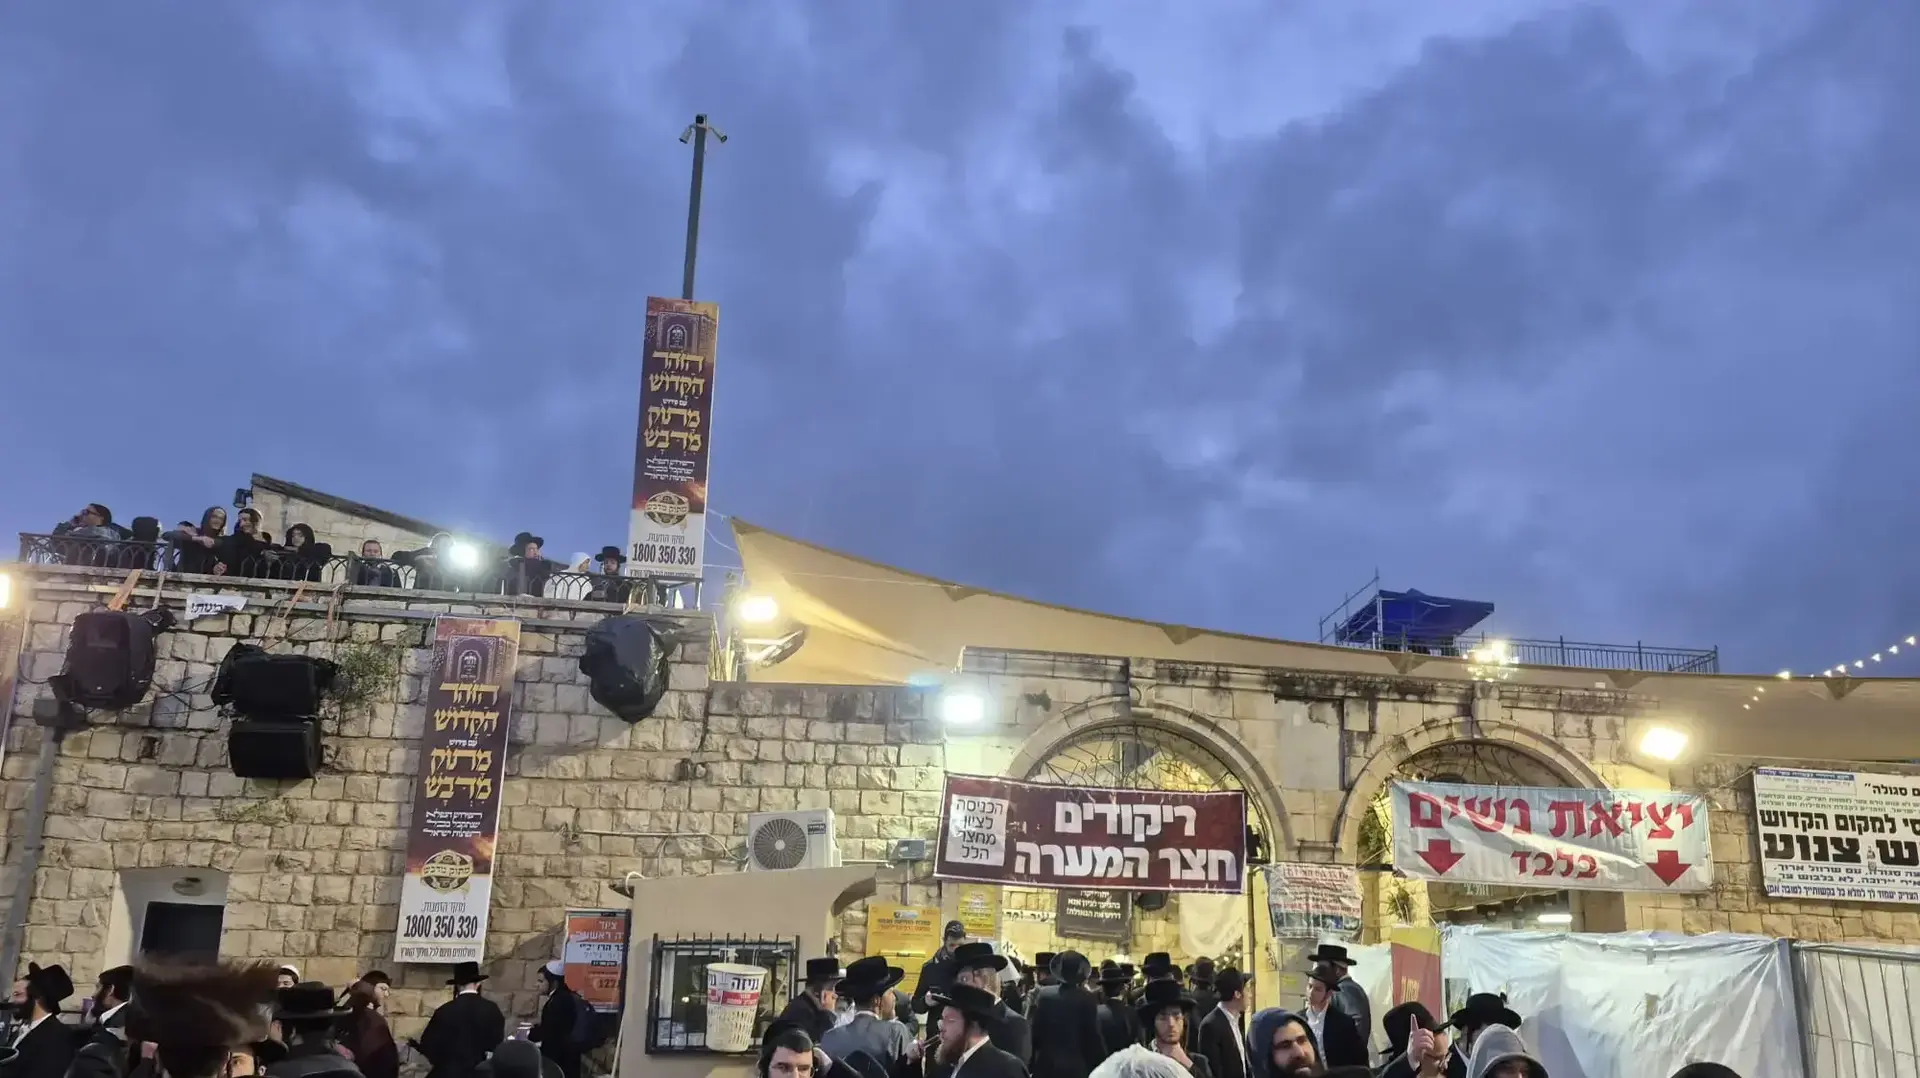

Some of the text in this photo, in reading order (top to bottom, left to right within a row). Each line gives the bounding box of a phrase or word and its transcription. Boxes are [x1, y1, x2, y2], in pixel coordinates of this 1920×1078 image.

[632, 543, 696, 565] 1800 350 330
[956, 798, 1005, 815] הכניסה
[1407, 791, 1694, 840] יציאת נשים
[963, 813, 994, 829] לציון
[1055, 800, 1197, 842] ריקודים
[1759, 810, 1829, 832] הקדוש
[1835, 814, 1897, 835] למקום
[958, 829, 997, 844] מחצר
[962, 844, 990, 860] הלל
[1763, 833, 1920, 866] ש צנוע
[1014, 842, 1238, 882] חצר המערה
[1510, 847, 1599, 879] בלבד
[404, 915, 478, 938] 1800 350 330
